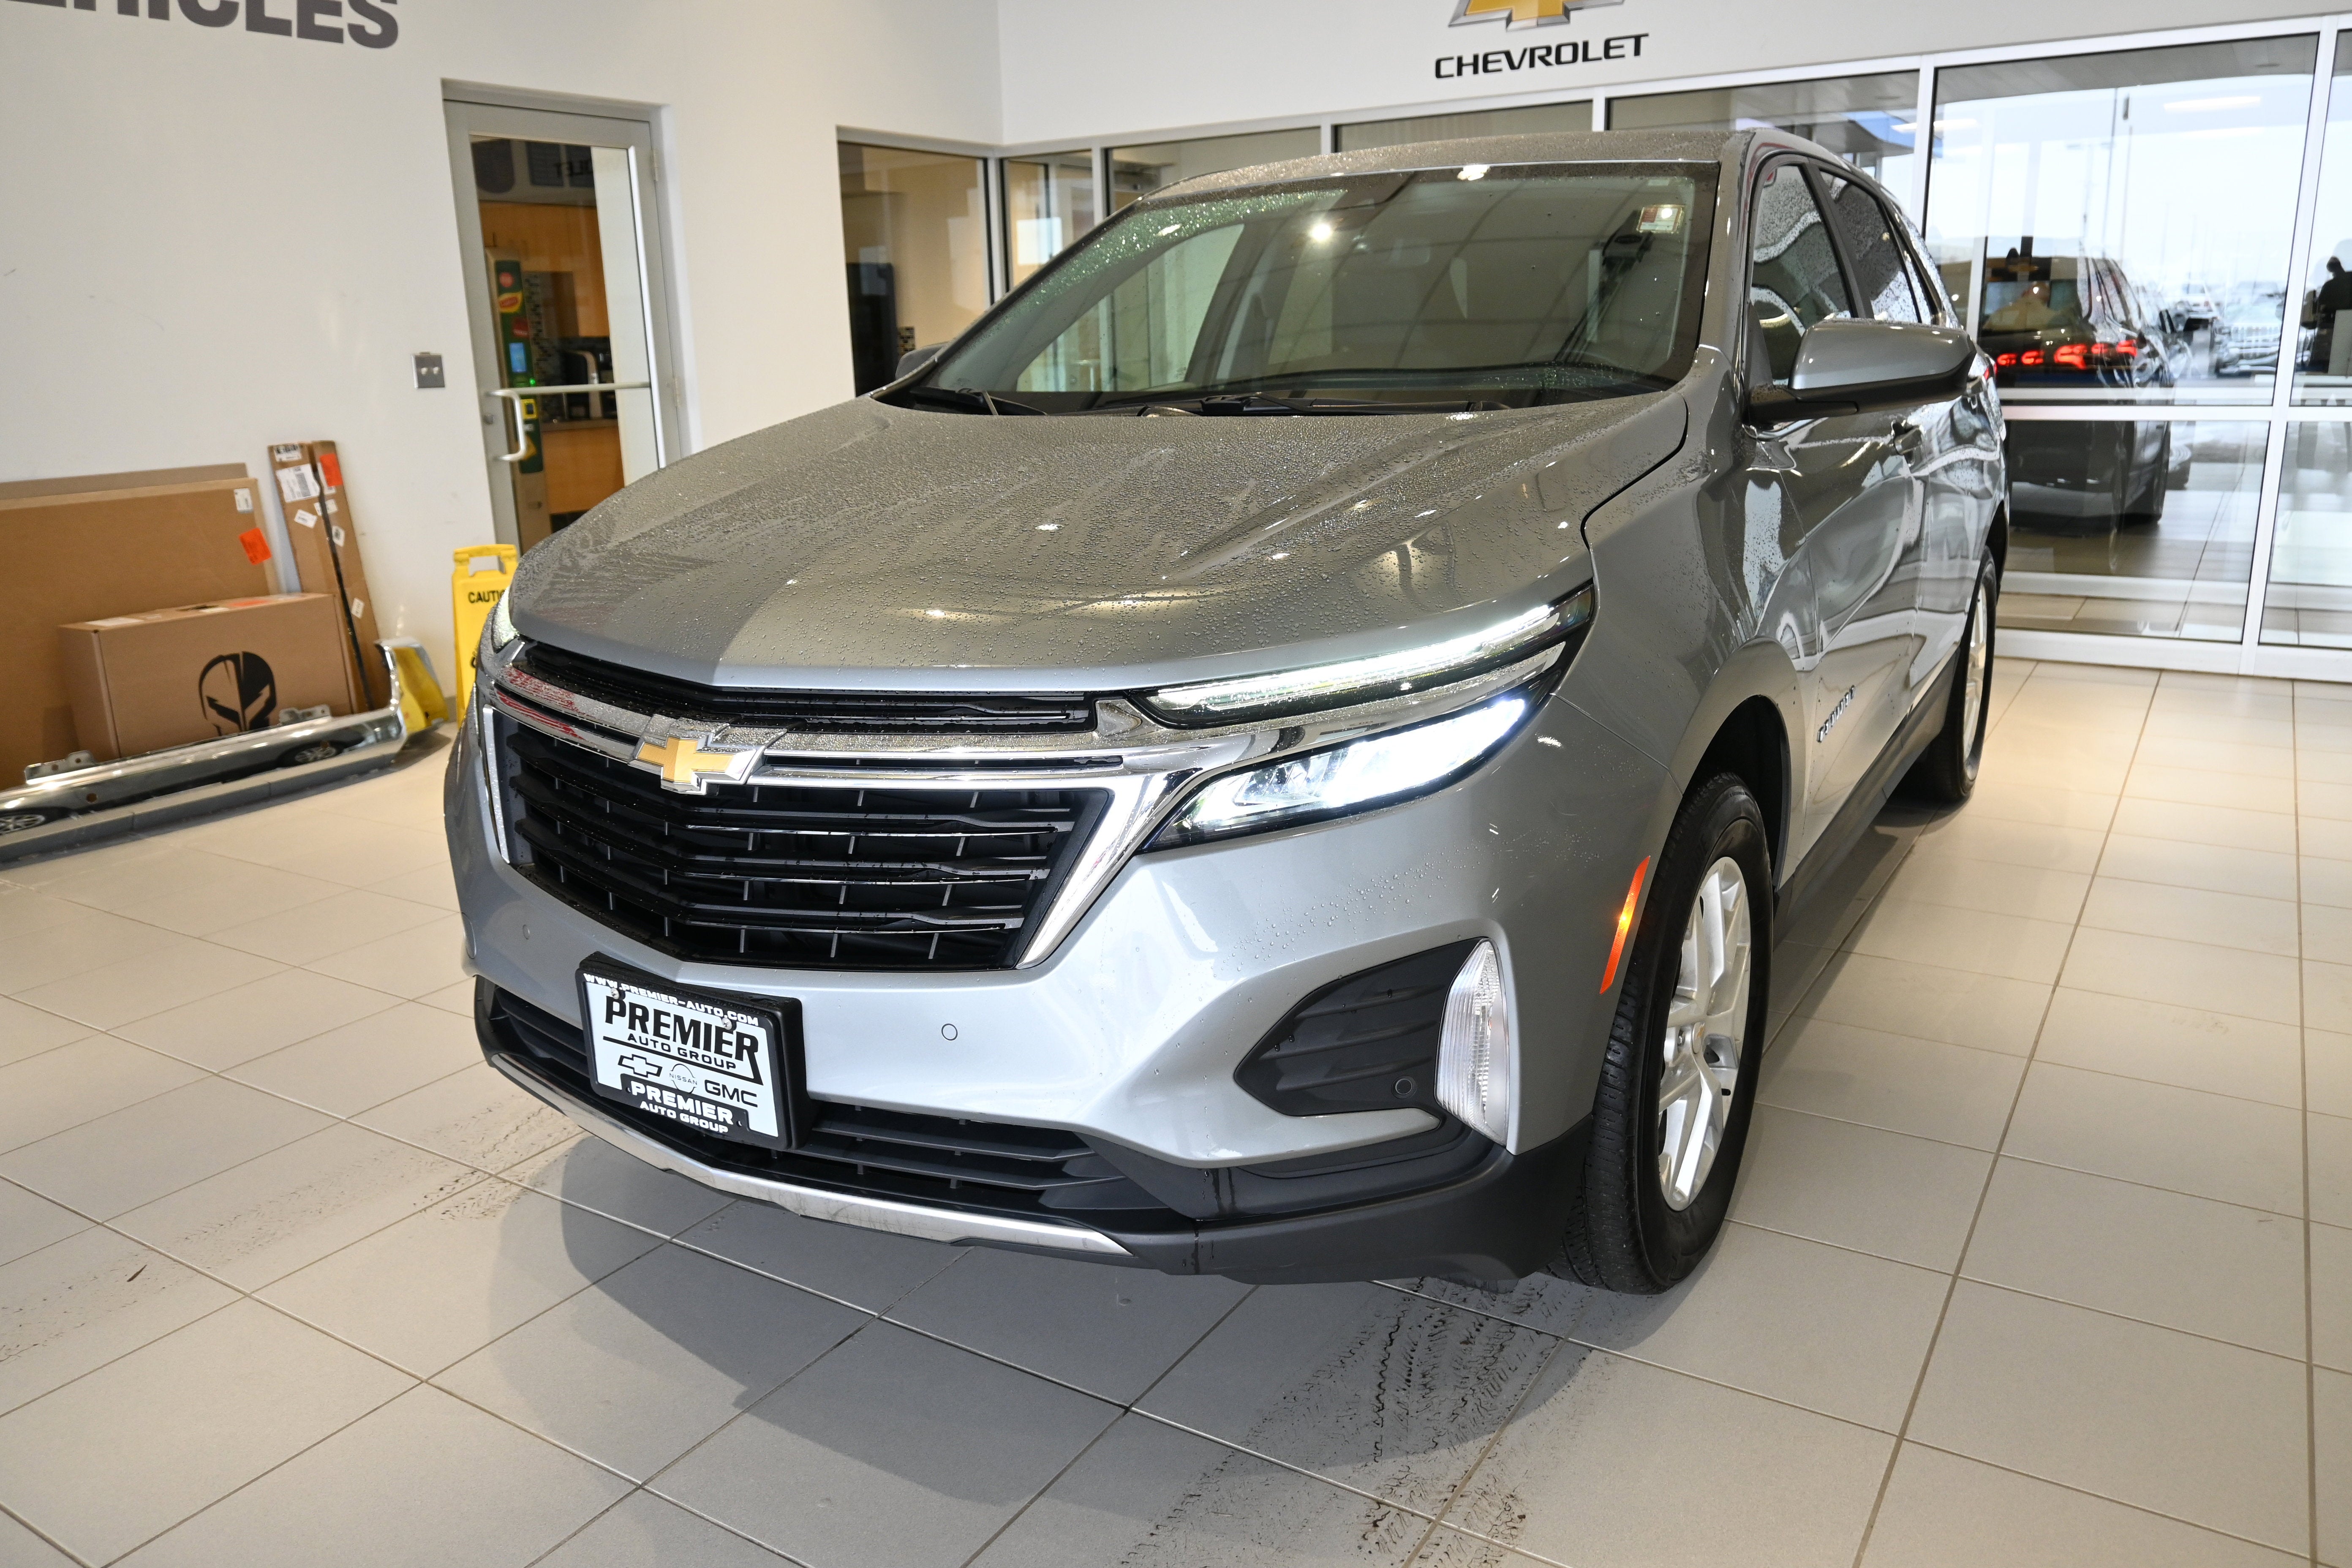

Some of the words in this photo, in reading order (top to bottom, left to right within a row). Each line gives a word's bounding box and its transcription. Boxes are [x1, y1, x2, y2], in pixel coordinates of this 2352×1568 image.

[1435, 33, 1649, 79] CHEVROLET
[583, 973, 759, 1026] WWW.PREMIER-AUTO.COM
[605, 995, 760, 1062] PREMIER
[627, 1033, 671, 1053] AUTO
[677, 1047, 736, 1070] GROUP
[669, 1072, 697, 1085] NISSAN
[704, 1079, 758, 1108] GMC
[630, 1081, 734, 1125] PREMIER
[640, 1101, 677, 1119] AUTO
[679, 1113, 729, 1134] GROUP
